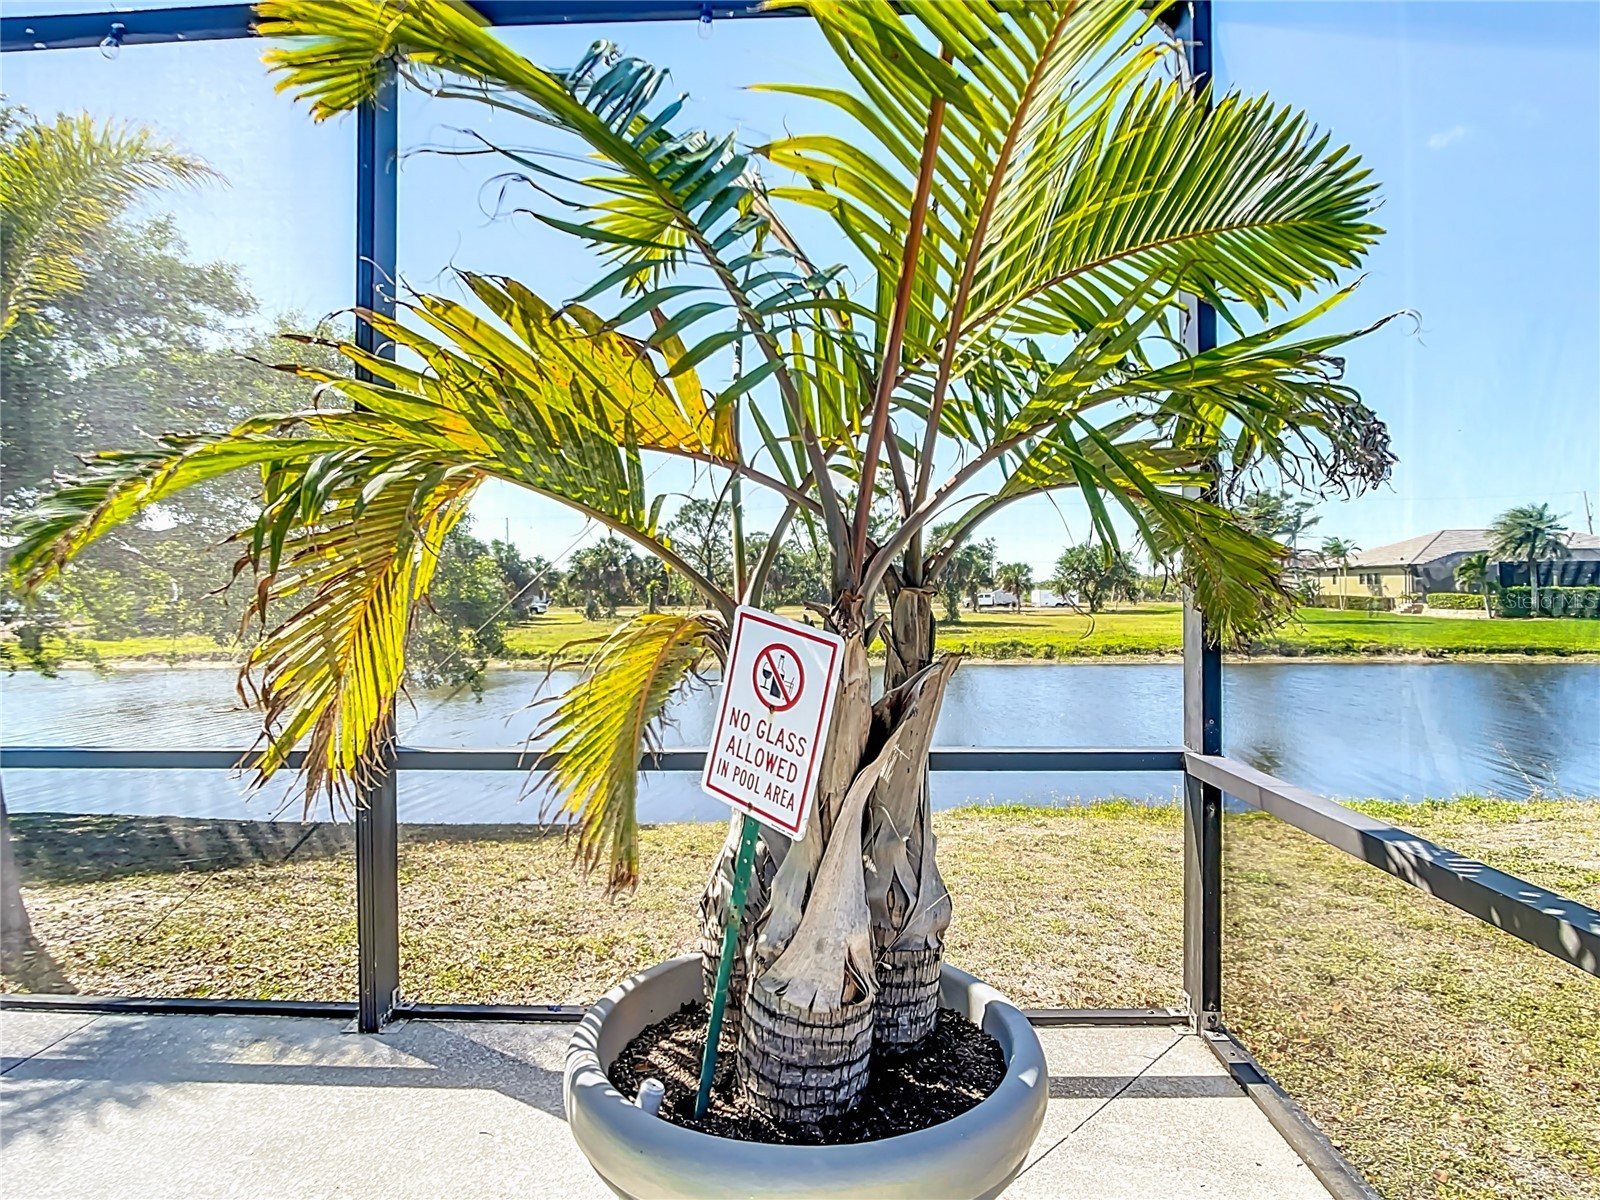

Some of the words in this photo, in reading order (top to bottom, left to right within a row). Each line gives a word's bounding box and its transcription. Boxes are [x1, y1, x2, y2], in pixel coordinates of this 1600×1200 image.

[729, 707, 751, 732] NO
[756, 719, 807, 758] GLASS
[716, 757, 730, 778] IN
[732, 765, 760, 795] POOL
[763, 782, 794, 812] AREA
[725, 735, 798, 784] ALLOWED
